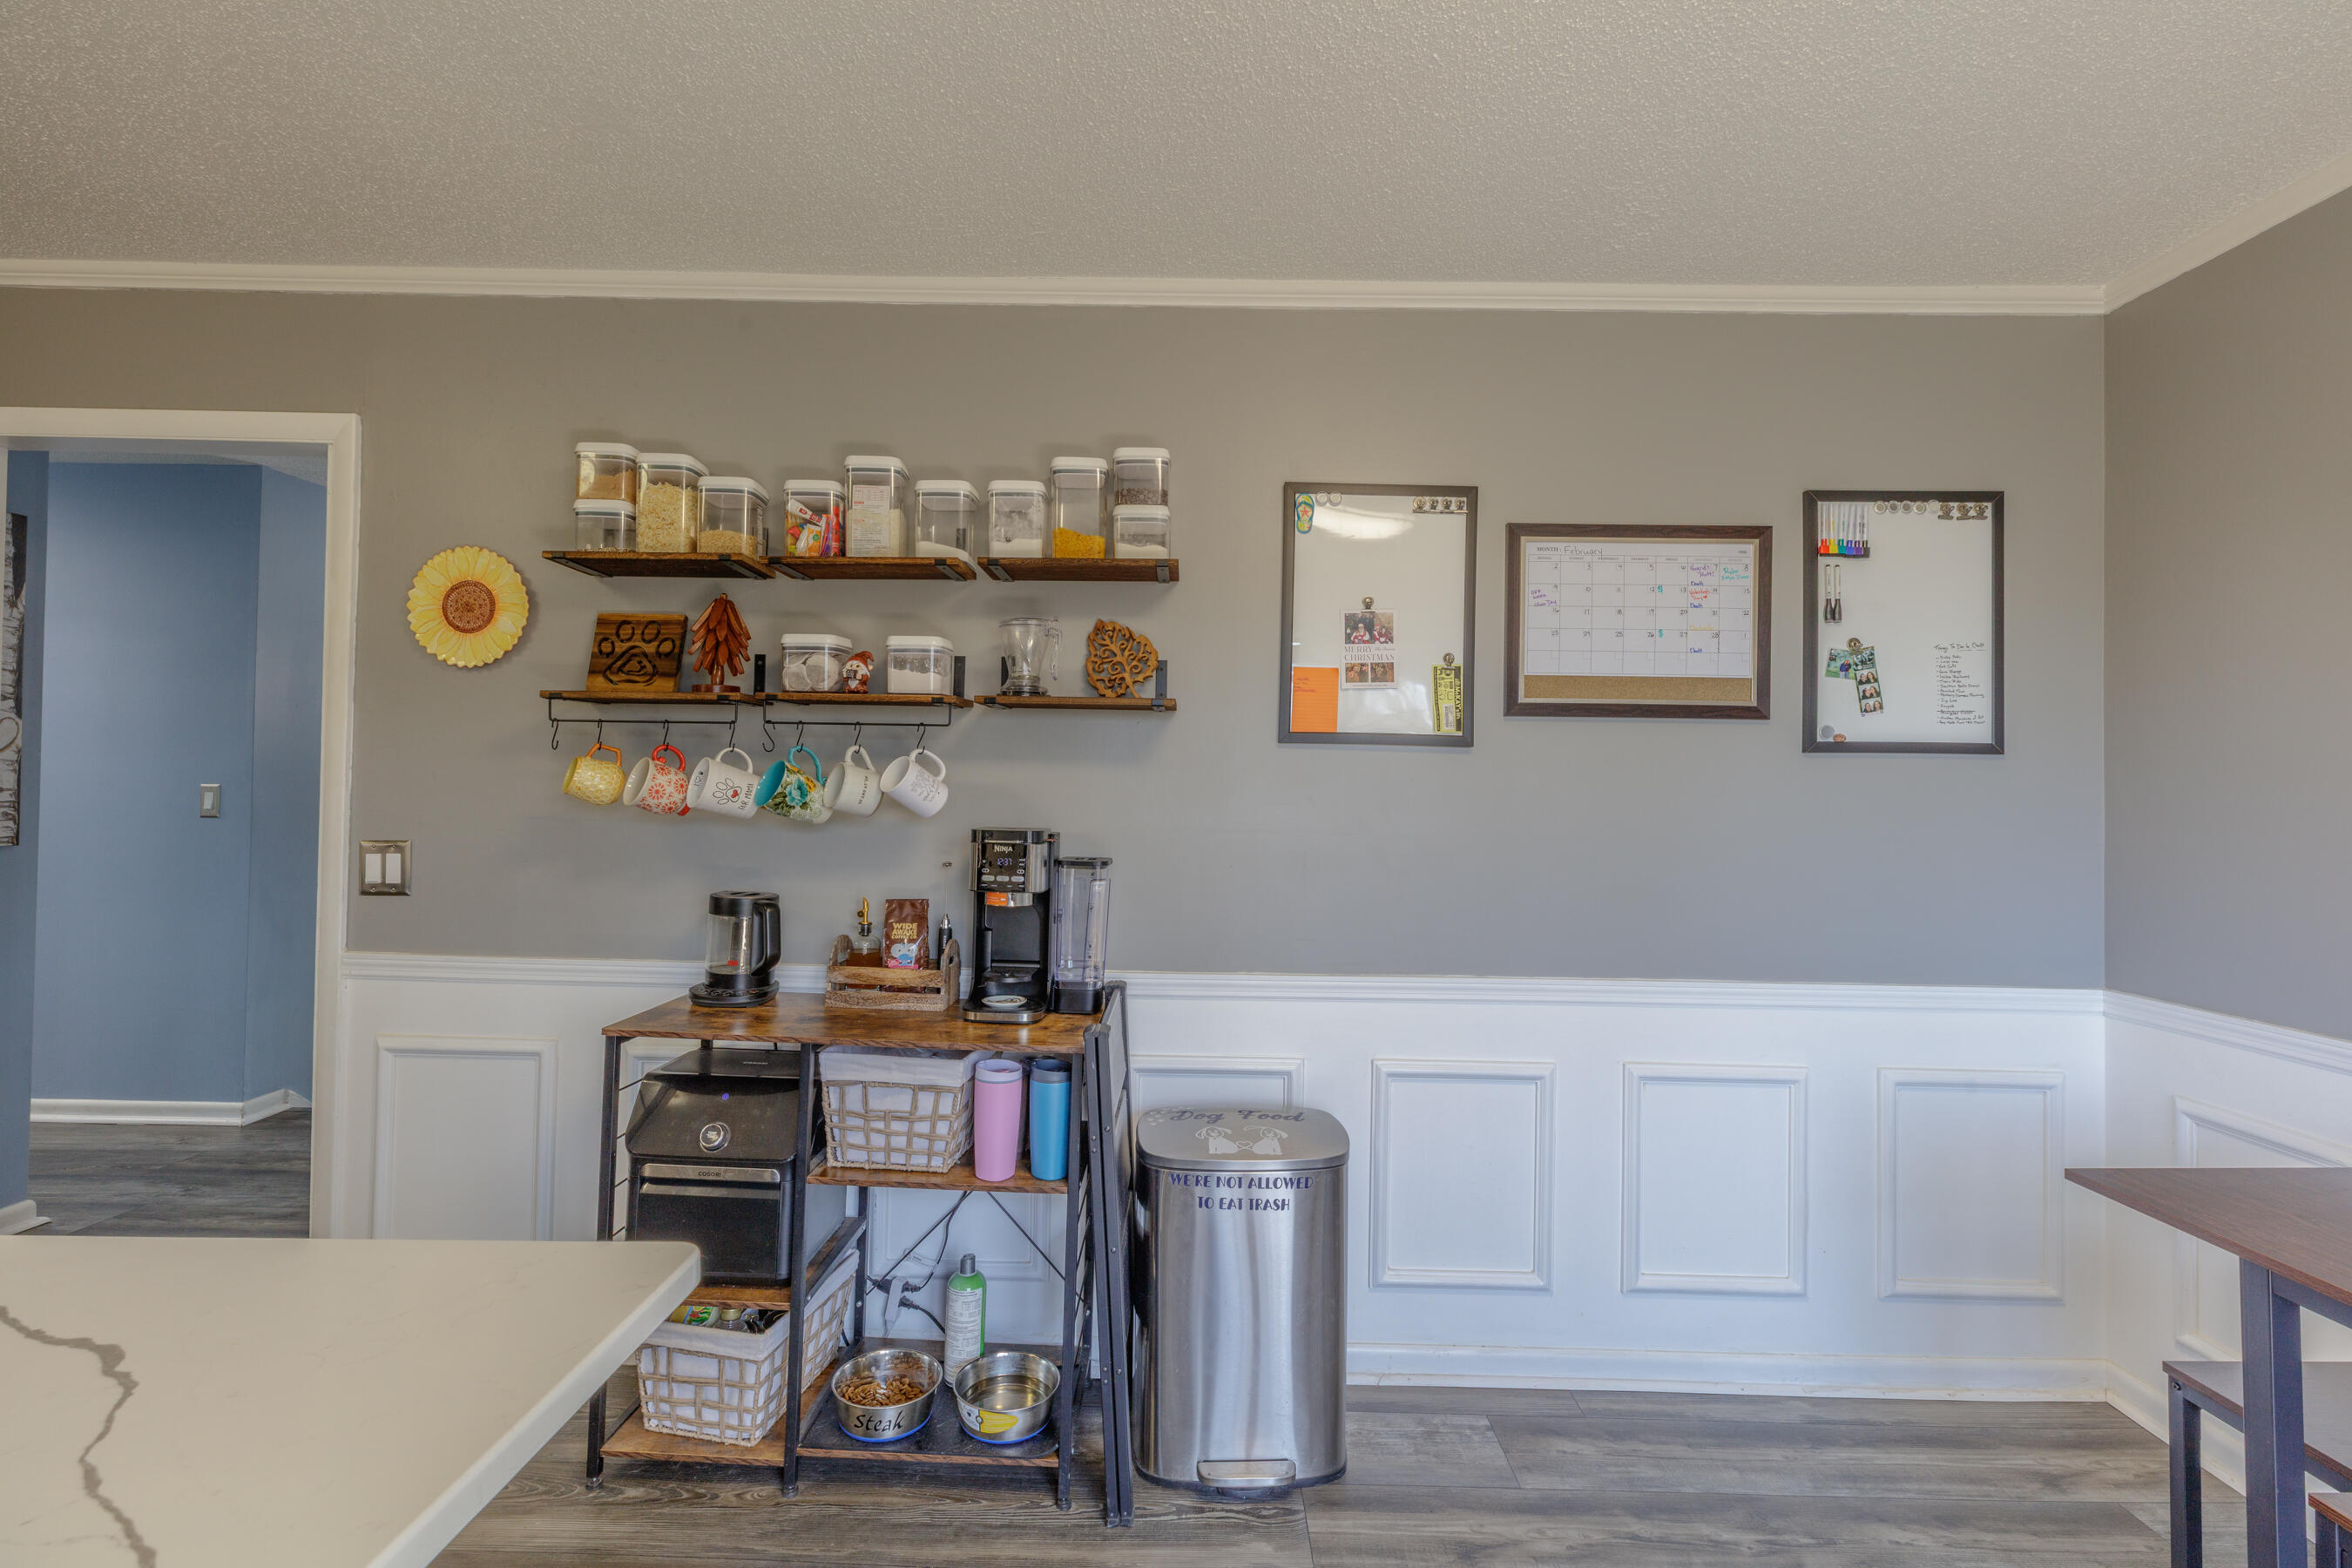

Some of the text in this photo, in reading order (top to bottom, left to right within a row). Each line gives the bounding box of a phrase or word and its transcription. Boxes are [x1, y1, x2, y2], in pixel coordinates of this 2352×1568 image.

[1564, 545, 1603, 561] February
[994, 844, 1013, 854] NINJA
[1169, 1109, 1306, 1125] Dog Food
[1169, 1173, 1314, 1190] WE'RE NOT ALLOWED
[1197, 1196, 1291, 1212] TO EAT TRASH
[854, 1409, 905, 1432] Steak
